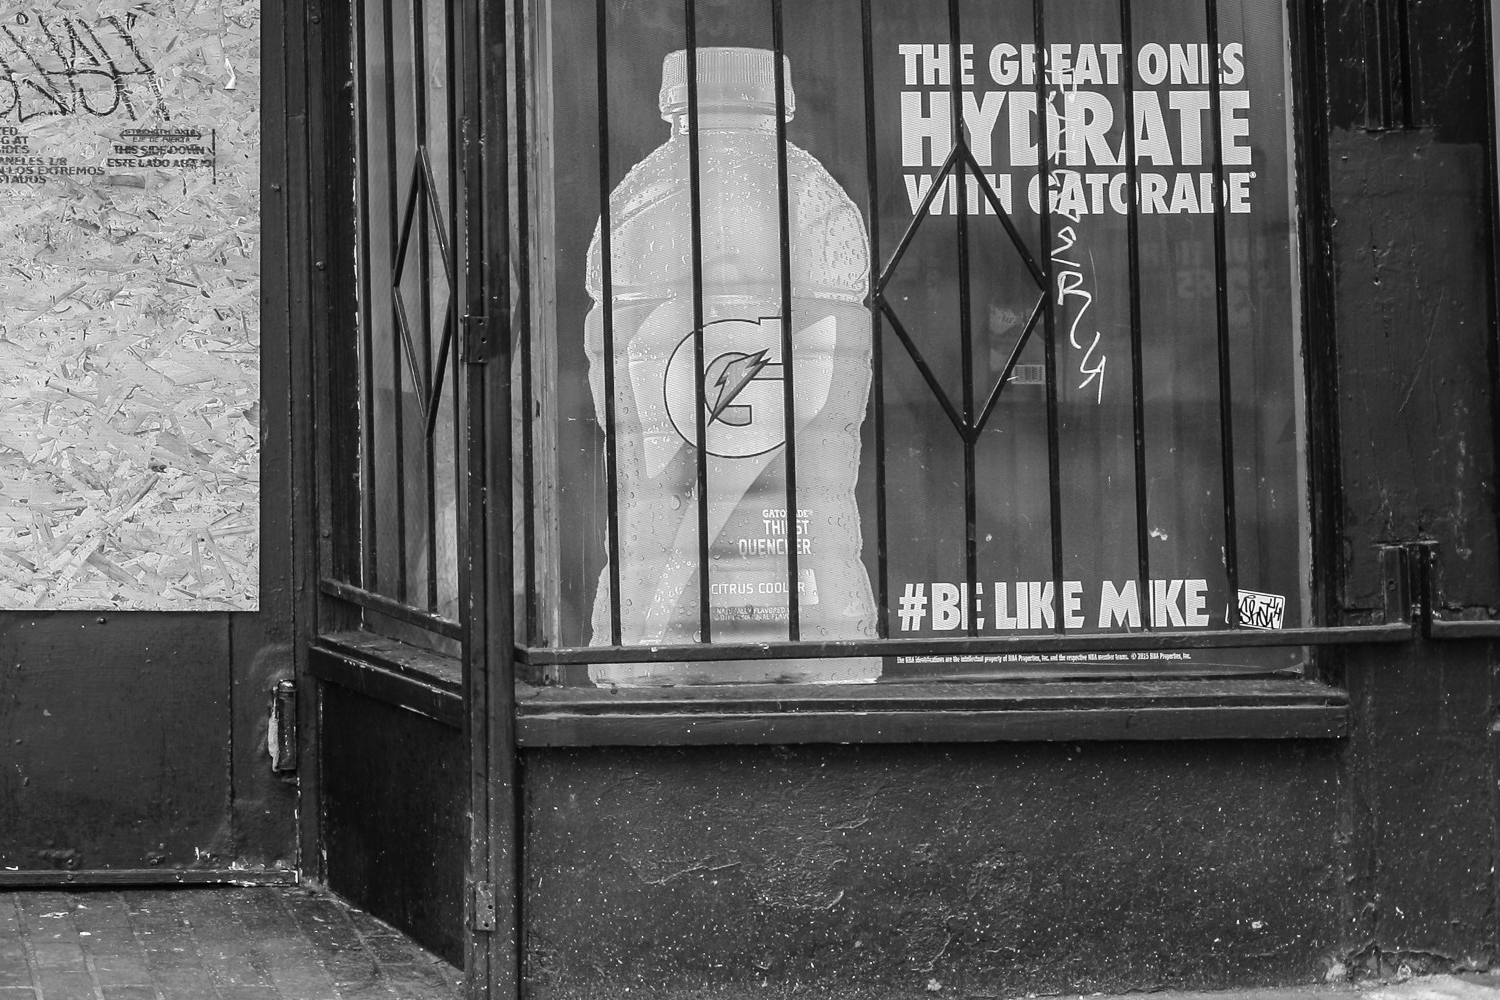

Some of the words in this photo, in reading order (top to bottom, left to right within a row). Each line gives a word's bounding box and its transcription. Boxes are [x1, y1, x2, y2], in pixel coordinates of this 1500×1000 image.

[899, 44, 974, 85] THE
[989, 43, 1122, 86] GREAT
[900, 91, 1251, 167] HYDRATE
[12, 136, 29, 144] AT
[114, 146, 138, 154] THIS
[141, 146, 167, 154] SIDE
[167, 146, 204, 154] DOWN
[48, 156, 67, 166] 1/8
[107, 158, 136, 167] ESTE
[138, 158, 170, 167] LADO
[8, 166, 34, 175] LOS
[38, 166, 105, 175] EXTREMOS
[904, 174, 1012, 215] WITH
[763, 520, 809, 535] THIST
[711, 582, 754, 594] CITRUS
[758, 582, 805, 594] COOLR
[898, 582, 985, 631] #BE
[995, 581, 1085, 629] LIKE
[960, 655, 983, 663] intellectual
[1018, 655, 1041, 663] Properties,
[1066, 654, 1087, 662] respective
[1160, 653, 1182, 661] Properties,
